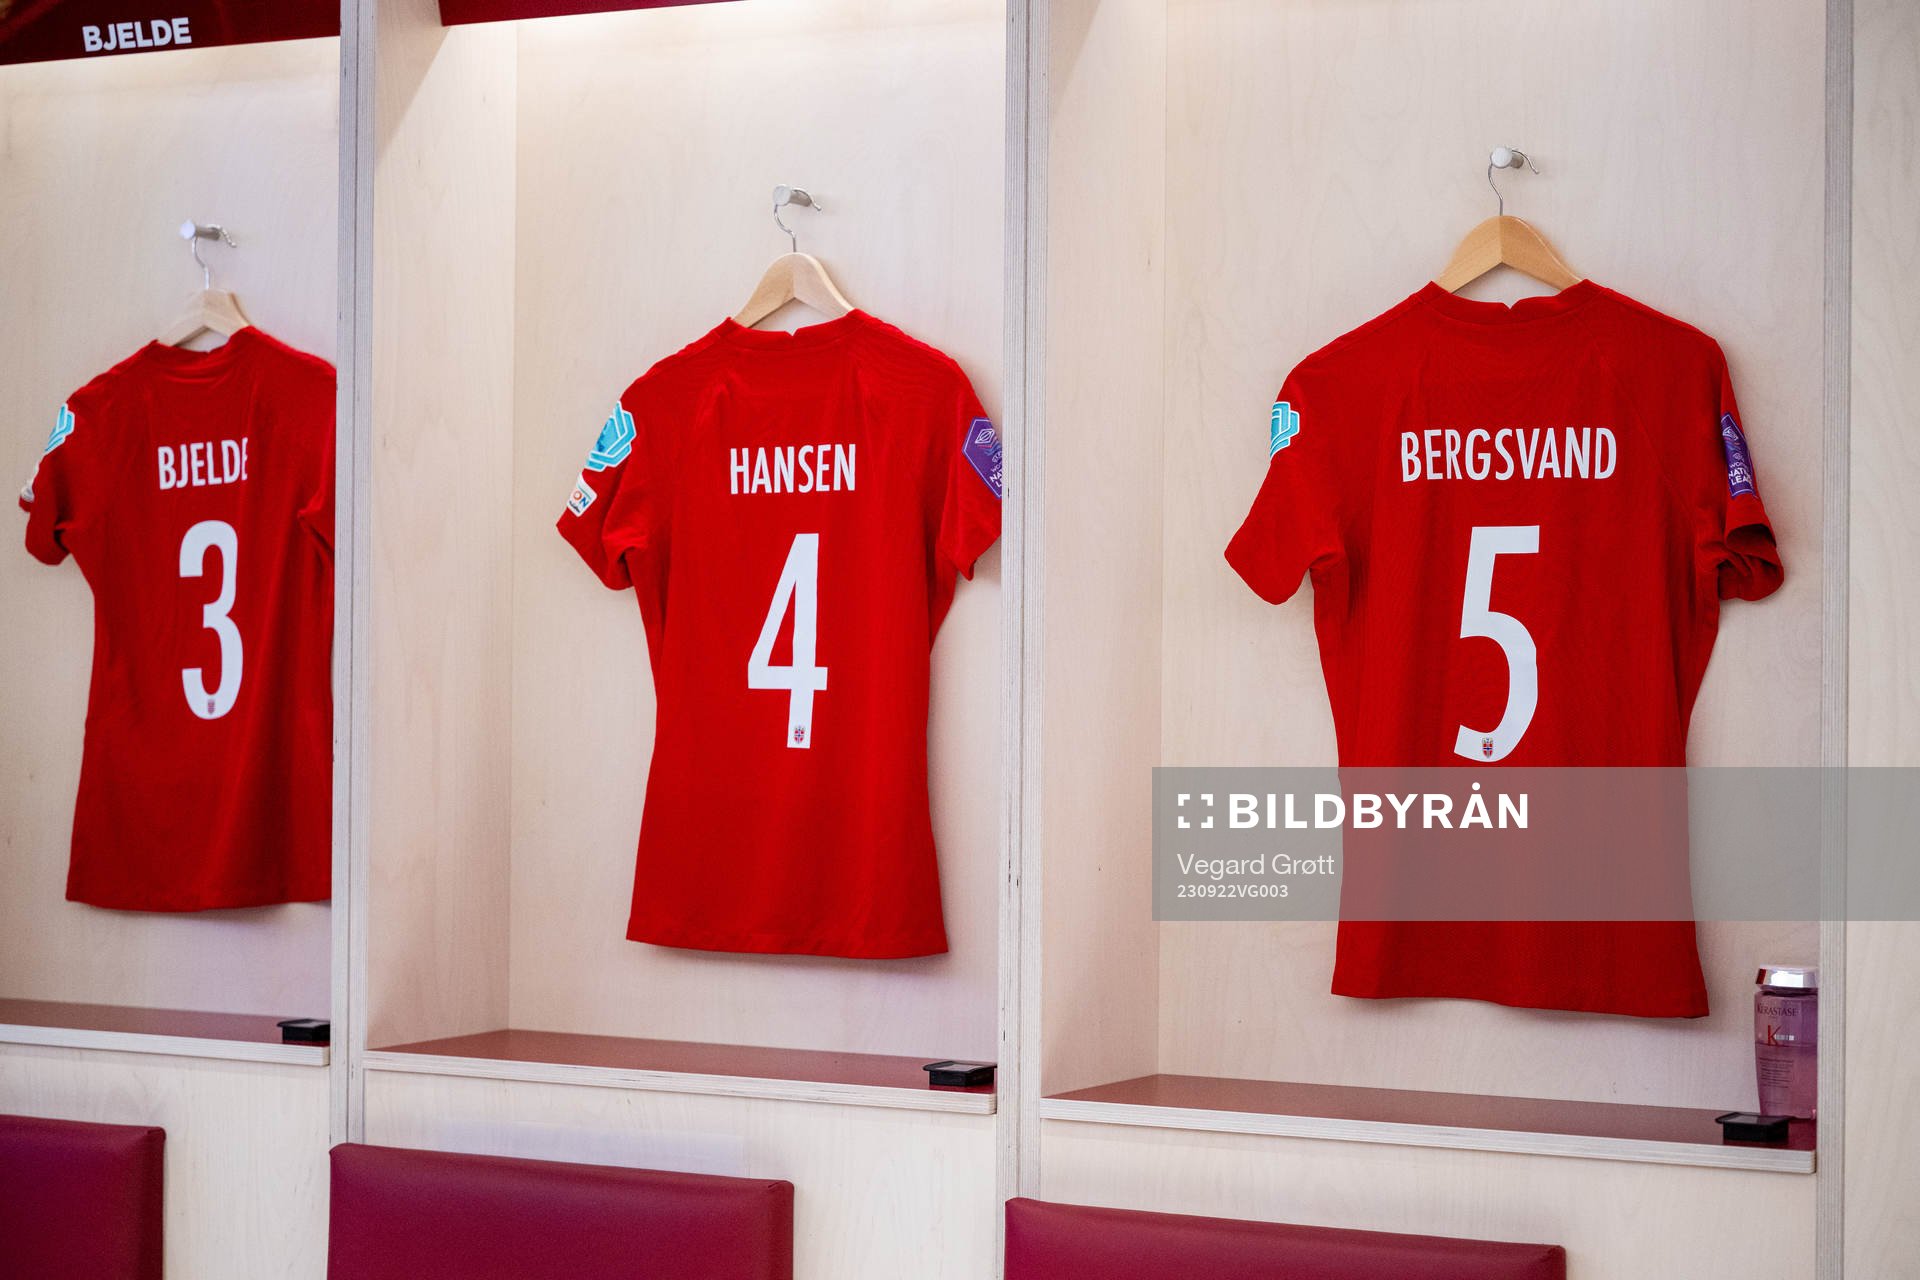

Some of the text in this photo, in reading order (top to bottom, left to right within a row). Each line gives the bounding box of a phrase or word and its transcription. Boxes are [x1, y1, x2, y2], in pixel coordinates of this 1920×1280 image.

[83, 17, 192, 52] BJELDE
[729, 443, 856, 496] HANSEN
[1400, 426, 1618, 484] BERGSVAND
[179, 520, 244, 720] 3
[747, 532, 828, 749] 4
[1453, 524, 1540, 763] 5
